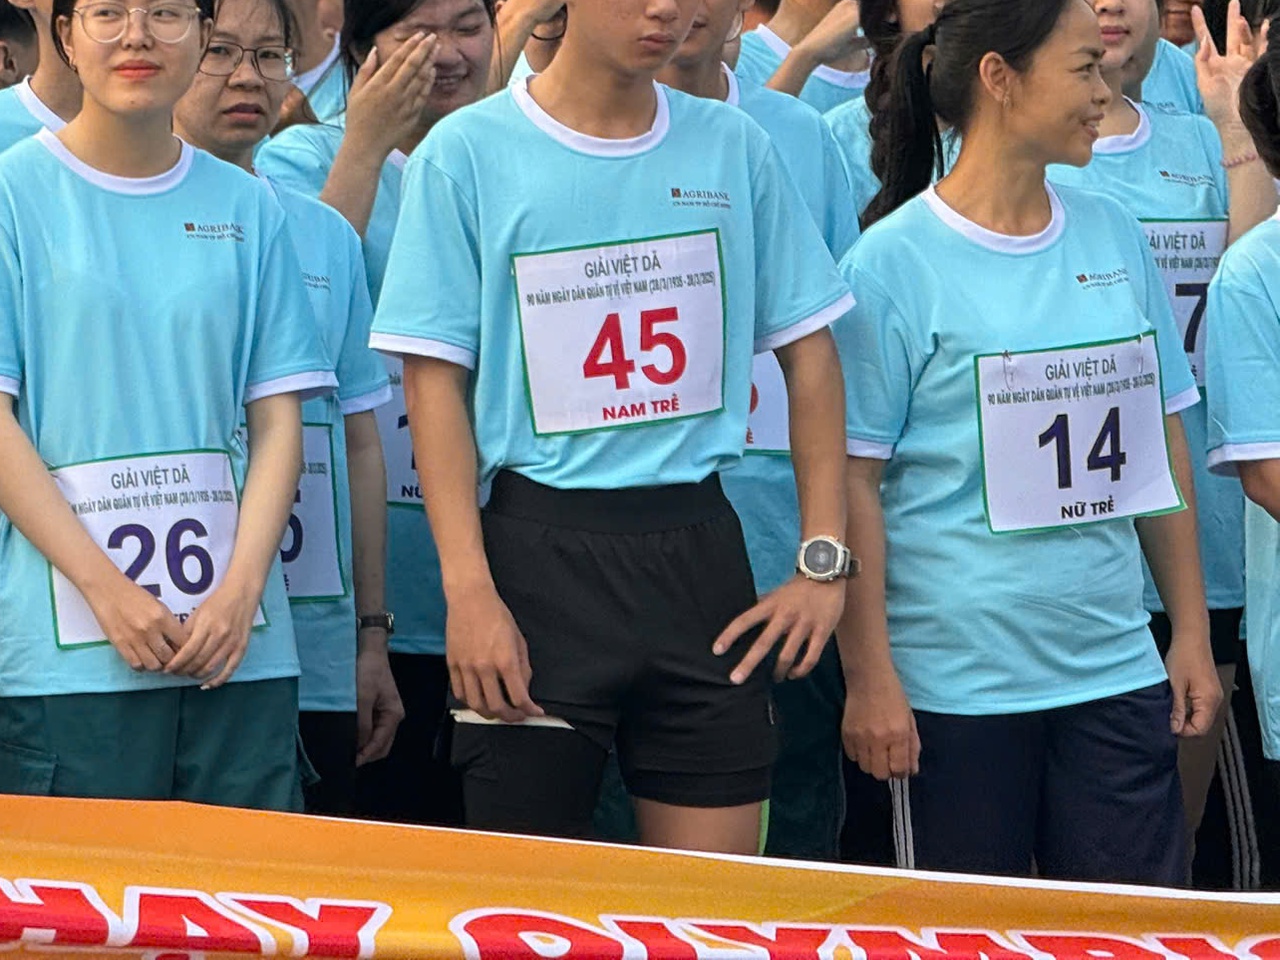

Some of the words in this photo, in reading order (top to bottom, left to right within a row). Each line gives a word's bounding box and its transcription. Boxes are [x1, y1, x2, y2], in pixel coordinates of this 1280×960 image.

[1163, 231, 1187, 253] VIỆT
[1191, 231, 1206, 250] DÃ
[585, 256, 610, 278] GIẢI
[612, 254, 639, 278] VIỆT
[642, 251, 661, 272] DÃ
[1175, 283, 1209, 353] 7
[583, 306, 686, 390] 45
[1045, 358, 1070, 380] GIẢI
[1072, 357, 1099, 380] VIỆT
[1102, 354, 1116, 374] DÃ
[603, 402, 646, 421] NAM
[651, 393, 680, 414] TRẺ
[1039, 406, 1127, 489] 14
[111, 467, 138, 489] GIẢI
[141, 466, 169, 489] VIỆT
[173, 465, 190, 484] DÃ
[1061, 502, 1086, 518] NỮ
[1091, 495, 1115, 516] TRẺ
[108, 518, 214, 597] 26
